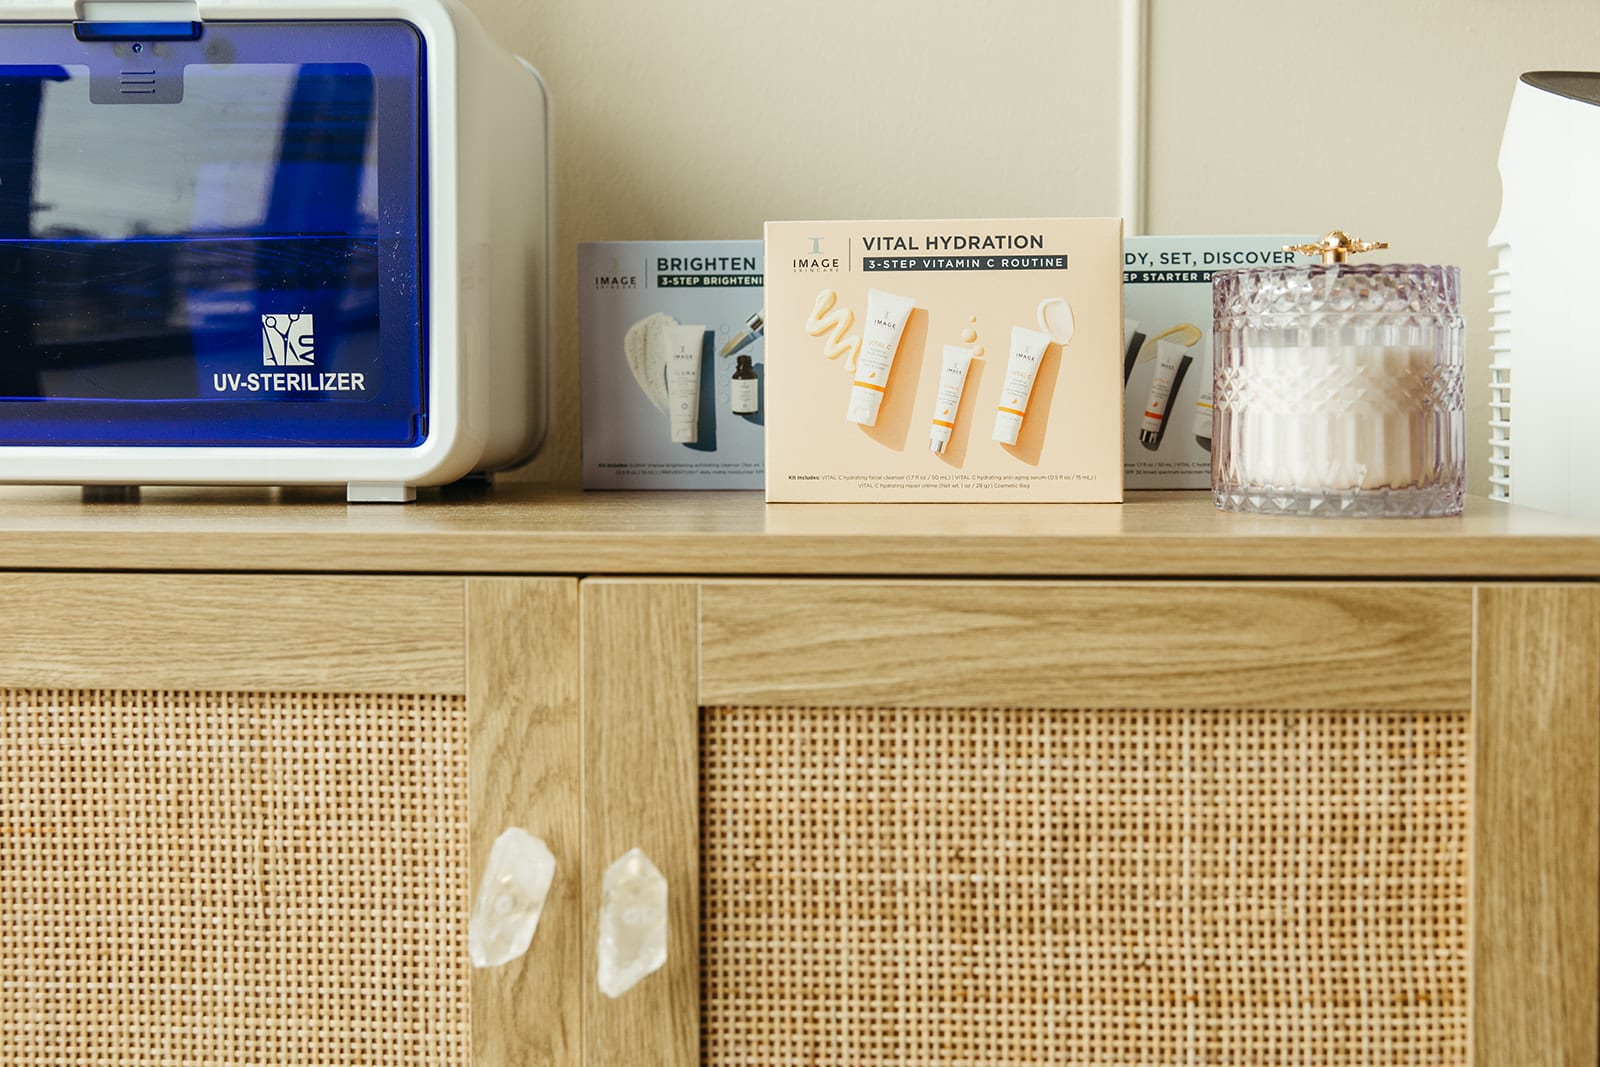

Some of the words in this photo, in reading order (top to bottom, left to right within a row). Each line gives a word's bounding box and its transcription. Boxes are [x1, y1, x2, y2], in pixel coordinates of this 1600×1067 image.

[862, 236, 919, 250] VITAL
[926, 235, 1043, 250] HYDRATION
[657, 257, 756, 271] BRIGHTEN
[793, 259, 839, 268] IMAGE
[868, 259, 917, 269] 3-STEP
[922, 259, 980, 268] VITAMIN
[986, 258, 995, 268] C
[1001, 258, 1063, 268] ROUTINE
[1160, 252, 1197, 267] SET,
[1203, 251, 1295, 265] DISCOVER
[595, 276, 636, 285] IMAGE
[662, 276, 700, 285] 3-STEP
[703, 276, 763, 285] BRIGHTENI
[1143, 272, 1198, 282] STARTER
[874, 319, 897, 329] IMAGE
[213, 372, 366, 392] UV-STERILIZER
